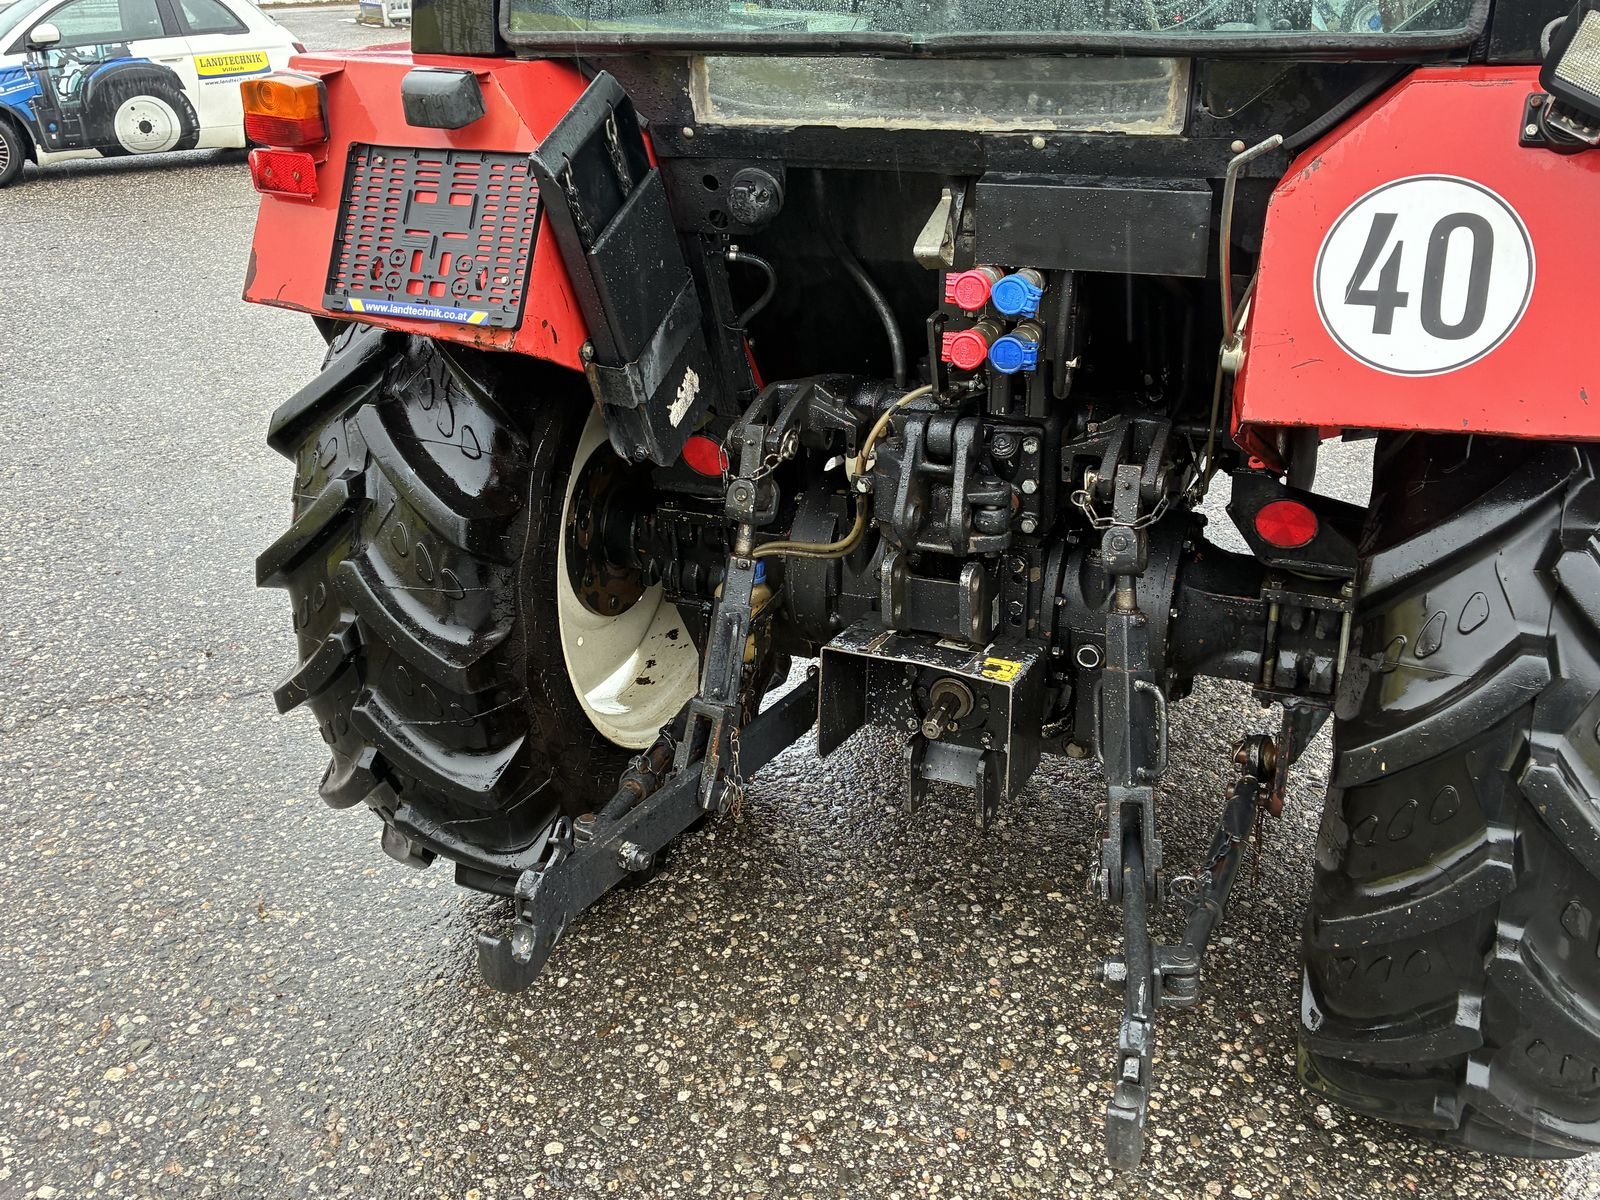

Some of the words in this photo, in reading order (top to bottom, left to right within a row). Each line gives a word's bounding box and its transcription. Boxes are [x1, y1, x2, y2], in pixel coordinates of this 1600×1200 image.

[199, 54, 262, 67] LANDTECHNIK
[1344, 212, 1494, 340] 40
[366, 303, 467, 321] www.landtechnik.co.at
